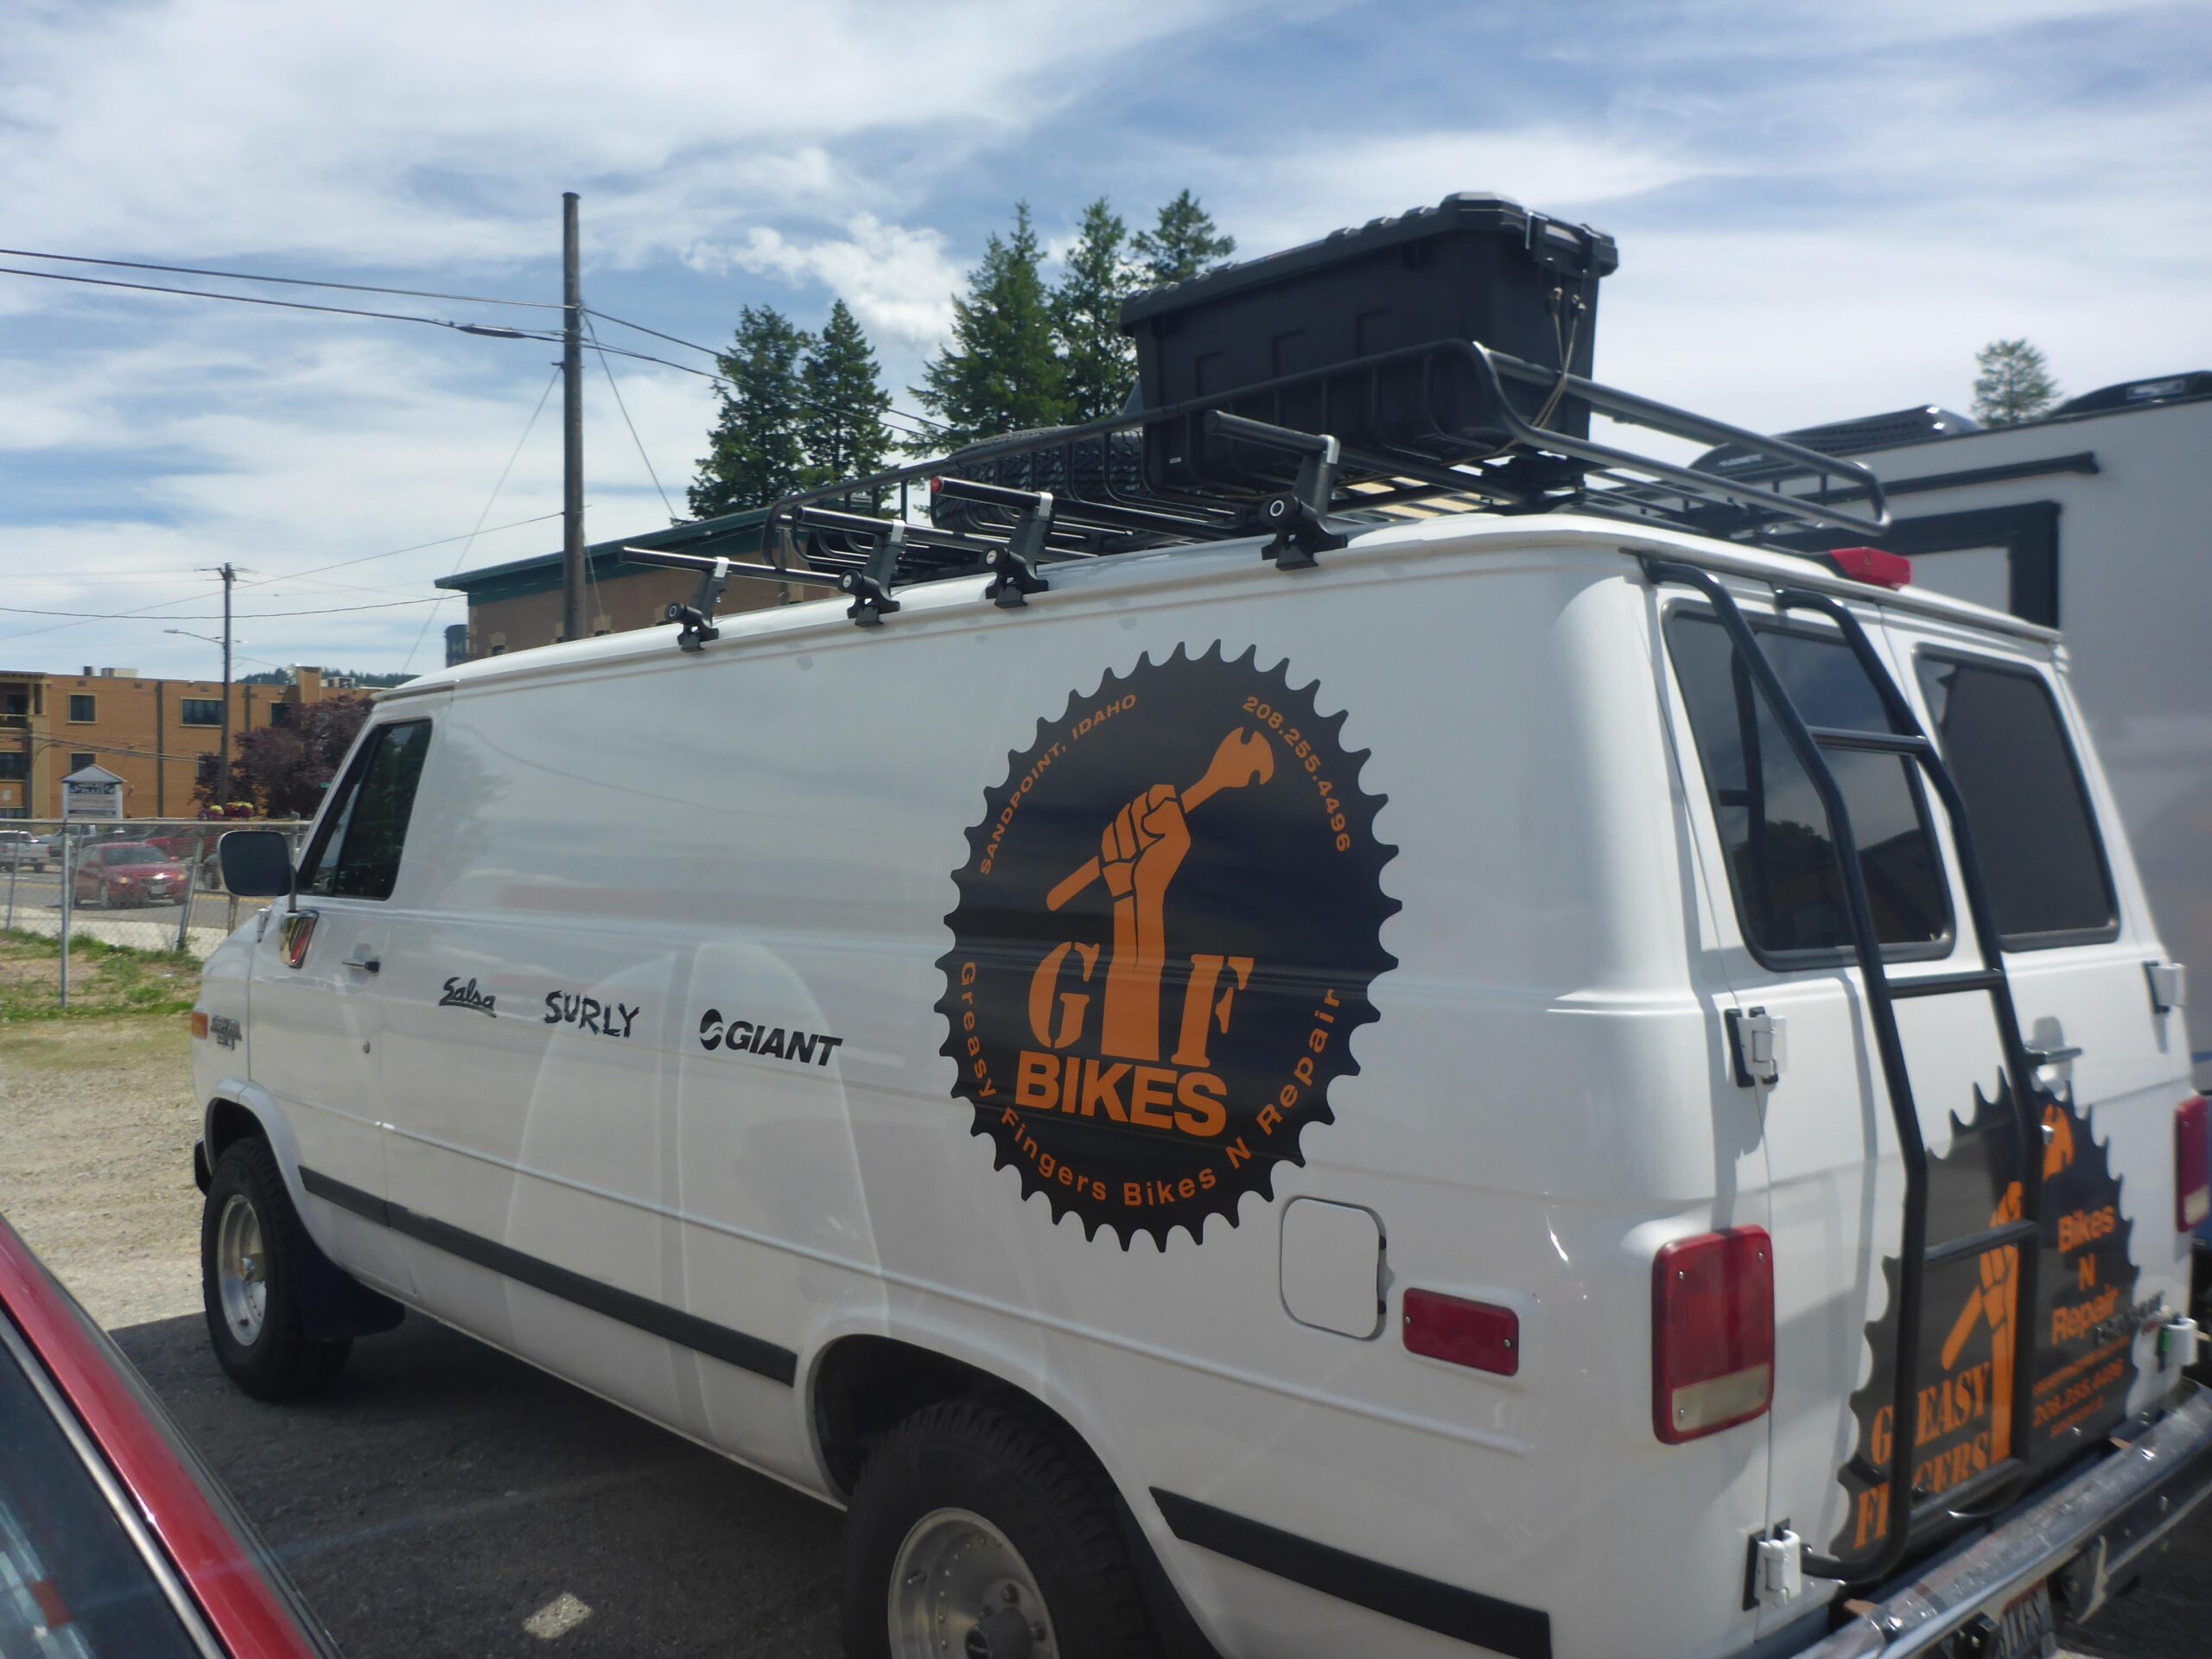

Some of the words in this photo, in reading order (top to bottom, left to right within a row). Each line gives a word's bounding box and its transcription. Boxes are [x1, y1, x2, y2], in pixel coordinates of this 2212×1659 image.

[981, 741, 1066, 874] SANDPOINT,
[1071, 694, 1137, 741] IDAHO
[1243, 695, 1351, 852] 208.255.4496
[439, 976, 496, 1018] Salsa
[543, 990, 639, 1039] SURLY
[725, 1020, 843, 1066] GIANT
[961, 961, 996, 1098] Greasy
[1001, 1106, 1108, 1202] Fingers
[1123, 1167, 1217, 1207] Bikes
[1225, 1136, 1252, 1169] N
[1256, 988, 1341, 1136] Repair
[1014, 1049, 1229, 1137] BIKES
[2057, 1205, 2116, 1255] Bikes
[2078, 1253, 2097, 1293] N
[2050, 1284, 2120, 1348] Repair
[1870, 1360, 1991, 1466] GEASY
